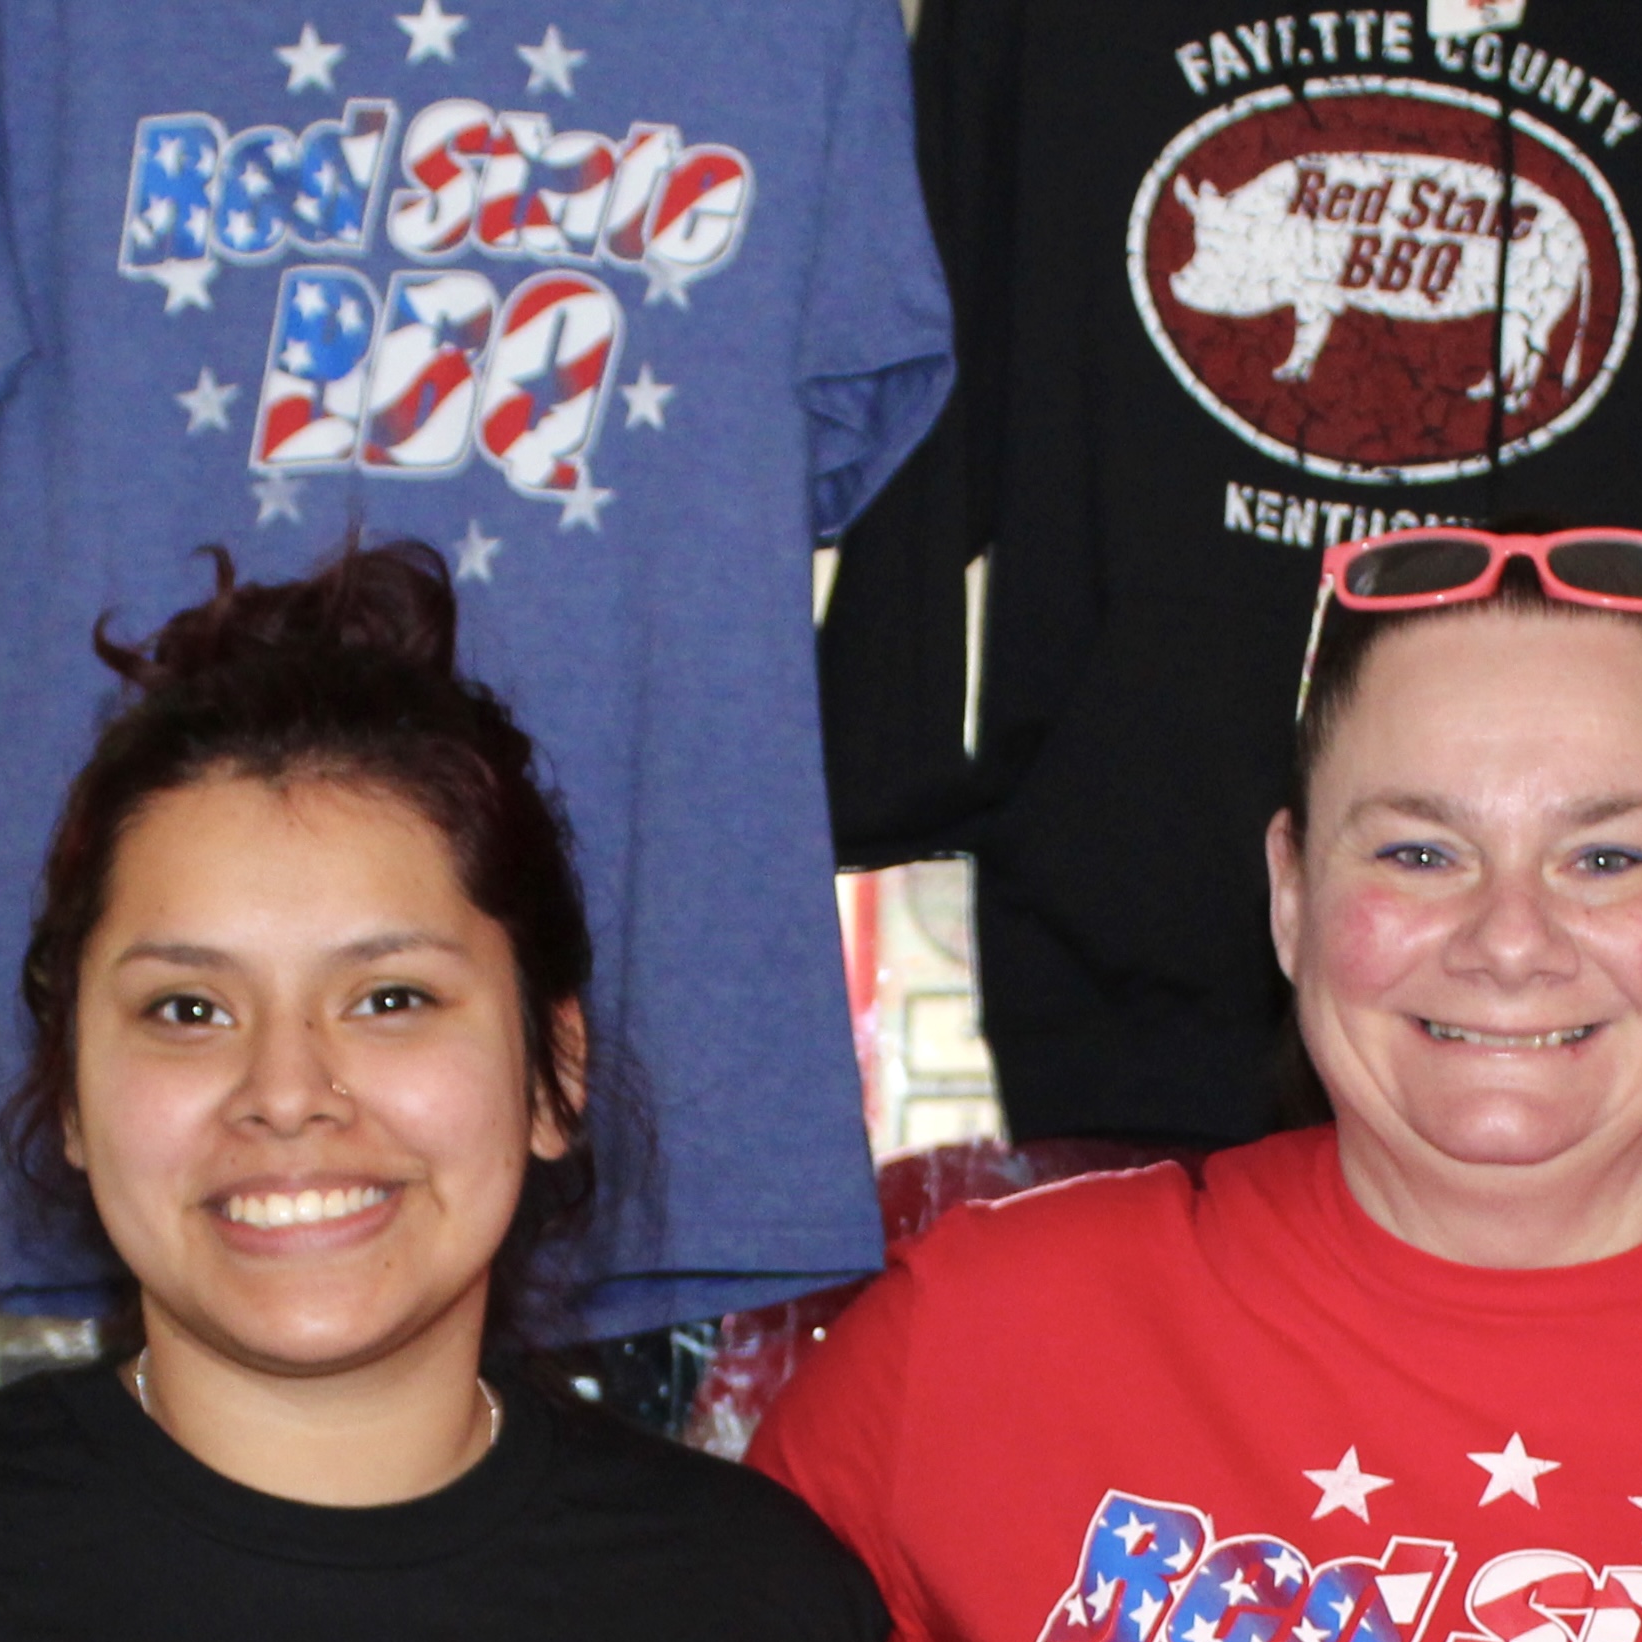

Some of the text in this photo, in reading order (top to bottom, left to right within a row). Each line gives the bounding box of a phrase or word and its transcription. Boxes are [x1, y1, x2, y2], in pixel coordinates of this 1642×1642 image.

[1434, 32, 1642, 149] COUNTY
[118, 98, 756, 275] Red State
[1287, 168, 1538, 241] Red State
[1338, 234, 1462, 303] BBQ
[248, 265, 626, 499] BBQ
[1224, 480, 1479, 549] KENTU
